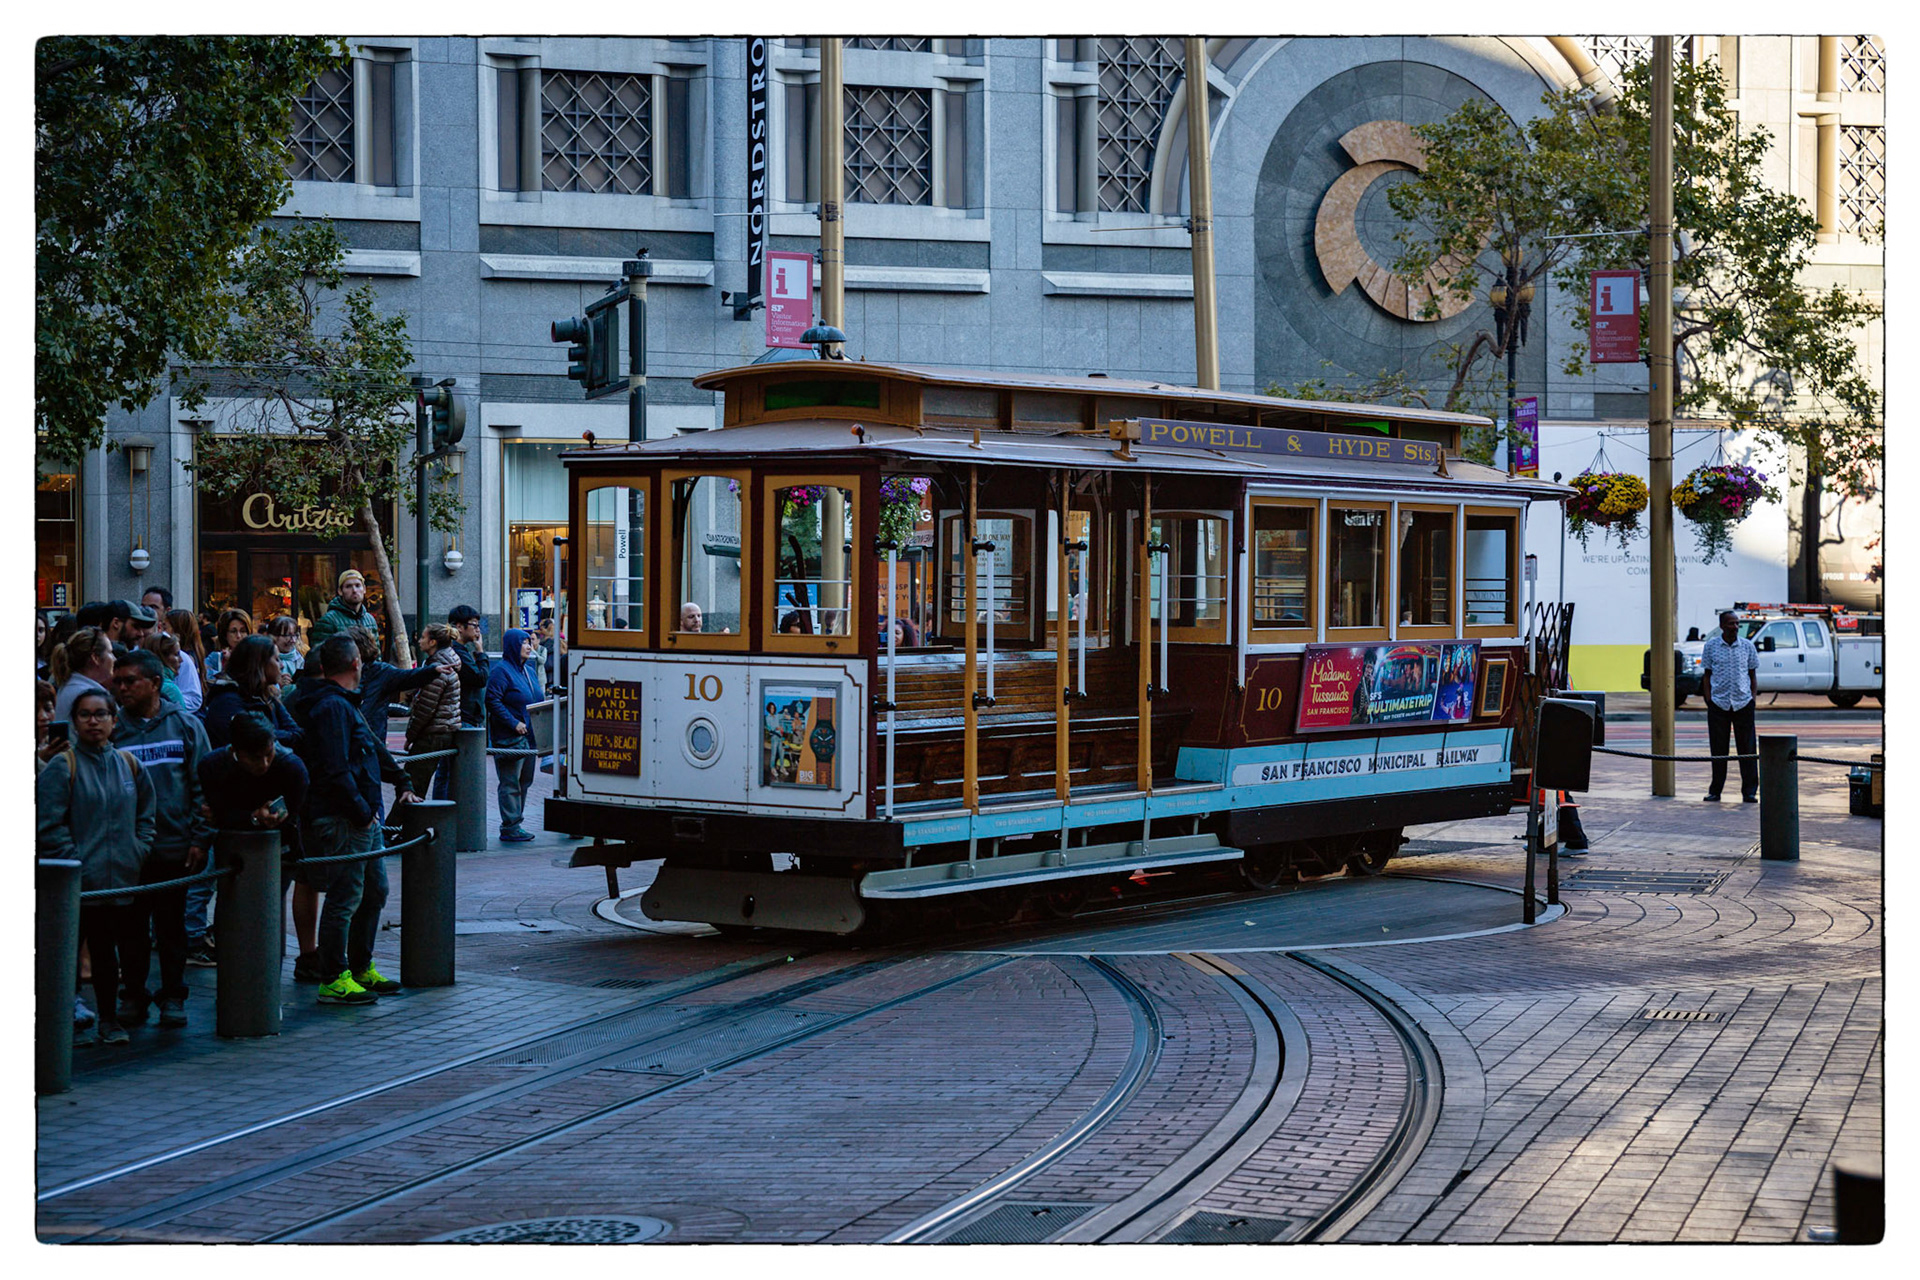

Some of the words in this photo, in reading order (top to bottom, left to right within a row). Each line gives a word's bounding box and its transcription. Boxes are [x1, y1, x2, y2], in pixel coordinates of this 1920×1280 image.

[771, 319, 807, 328] Information
[1150, 424, 1262, 448] POWELL
[1286, 435, 1302, 452] &
[1328, 438, 1390, 459] HYDE
[1404, 443, 1435, 462] Sts.
[242, 492, 354, 530] Aritzia
[618, 529, 627, 559] Powell
[1582, 555, 1609, 564] WE'RE
[1611, 554, 1650, 564] UPDATIN
[1311, 659, 1352, 683] Madame
[587, 686, 638, 700] POWELL
[683, 673, 723, 702] 10
[1310, 681, 1350, 704] Tussauds
[601, 699, 627, 709] AND
[1255, 687, 1282, 711] 10
[586, 707, 639, 721] MARKET
[1307, 708, 1318, 716] SAN
[1320, 706, 1350, 715] FRANCISCO
[585, 733, 603, 747] HYDE
[613, 735, 638, 750] BEACH
[588, 749, 632, 762] FISHERMANS
[597, 760, 621, 770] WHARF
[1261, 764, 1288, 781] SAN
[1292, 758, 1361, 779] FRANCISCO
[1436, 748, 1479, 766] RAILWAY
